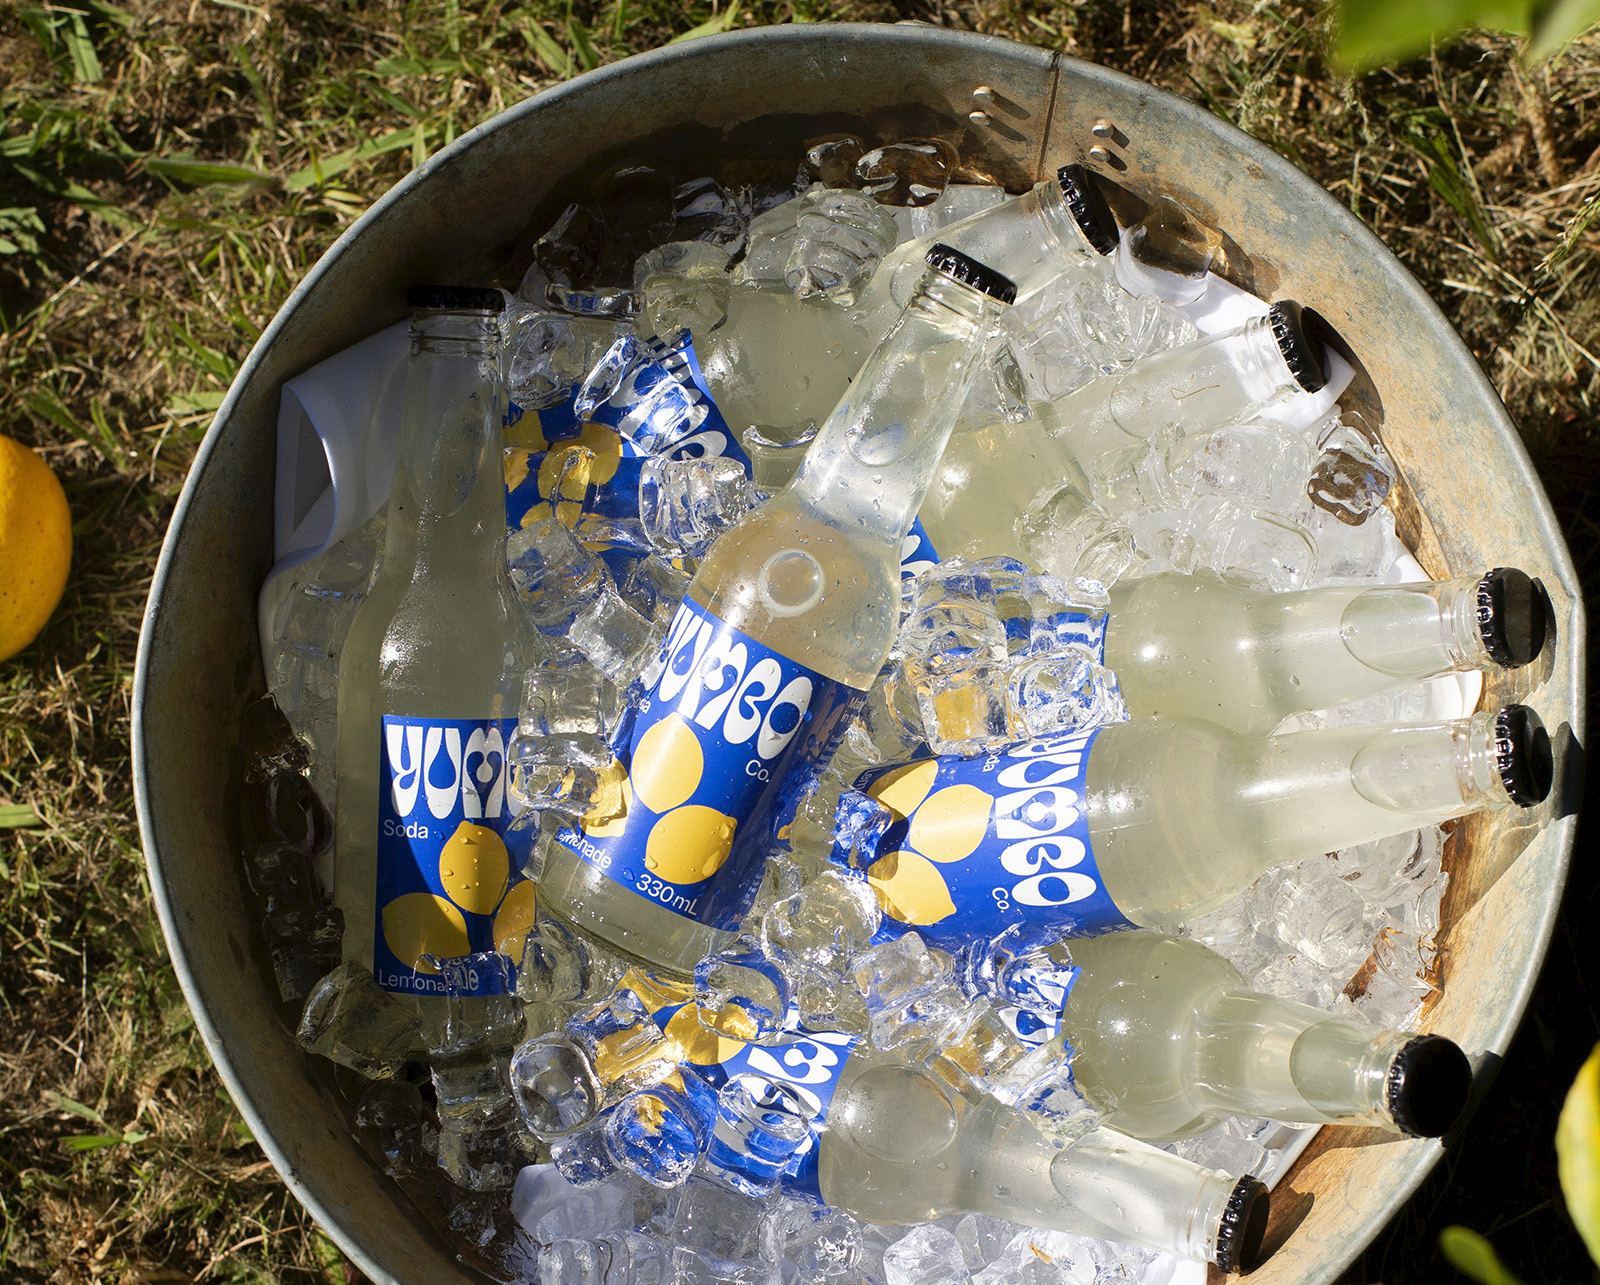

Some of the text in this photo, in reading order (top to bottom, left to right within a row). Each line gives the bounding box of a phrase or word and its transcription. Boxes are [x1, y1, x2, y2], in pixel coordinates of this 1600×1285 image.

[745, 759, 771, 783] Co.
[383, 819, 429, 840] Soda
[991, 886, 1010, 914] Co.
